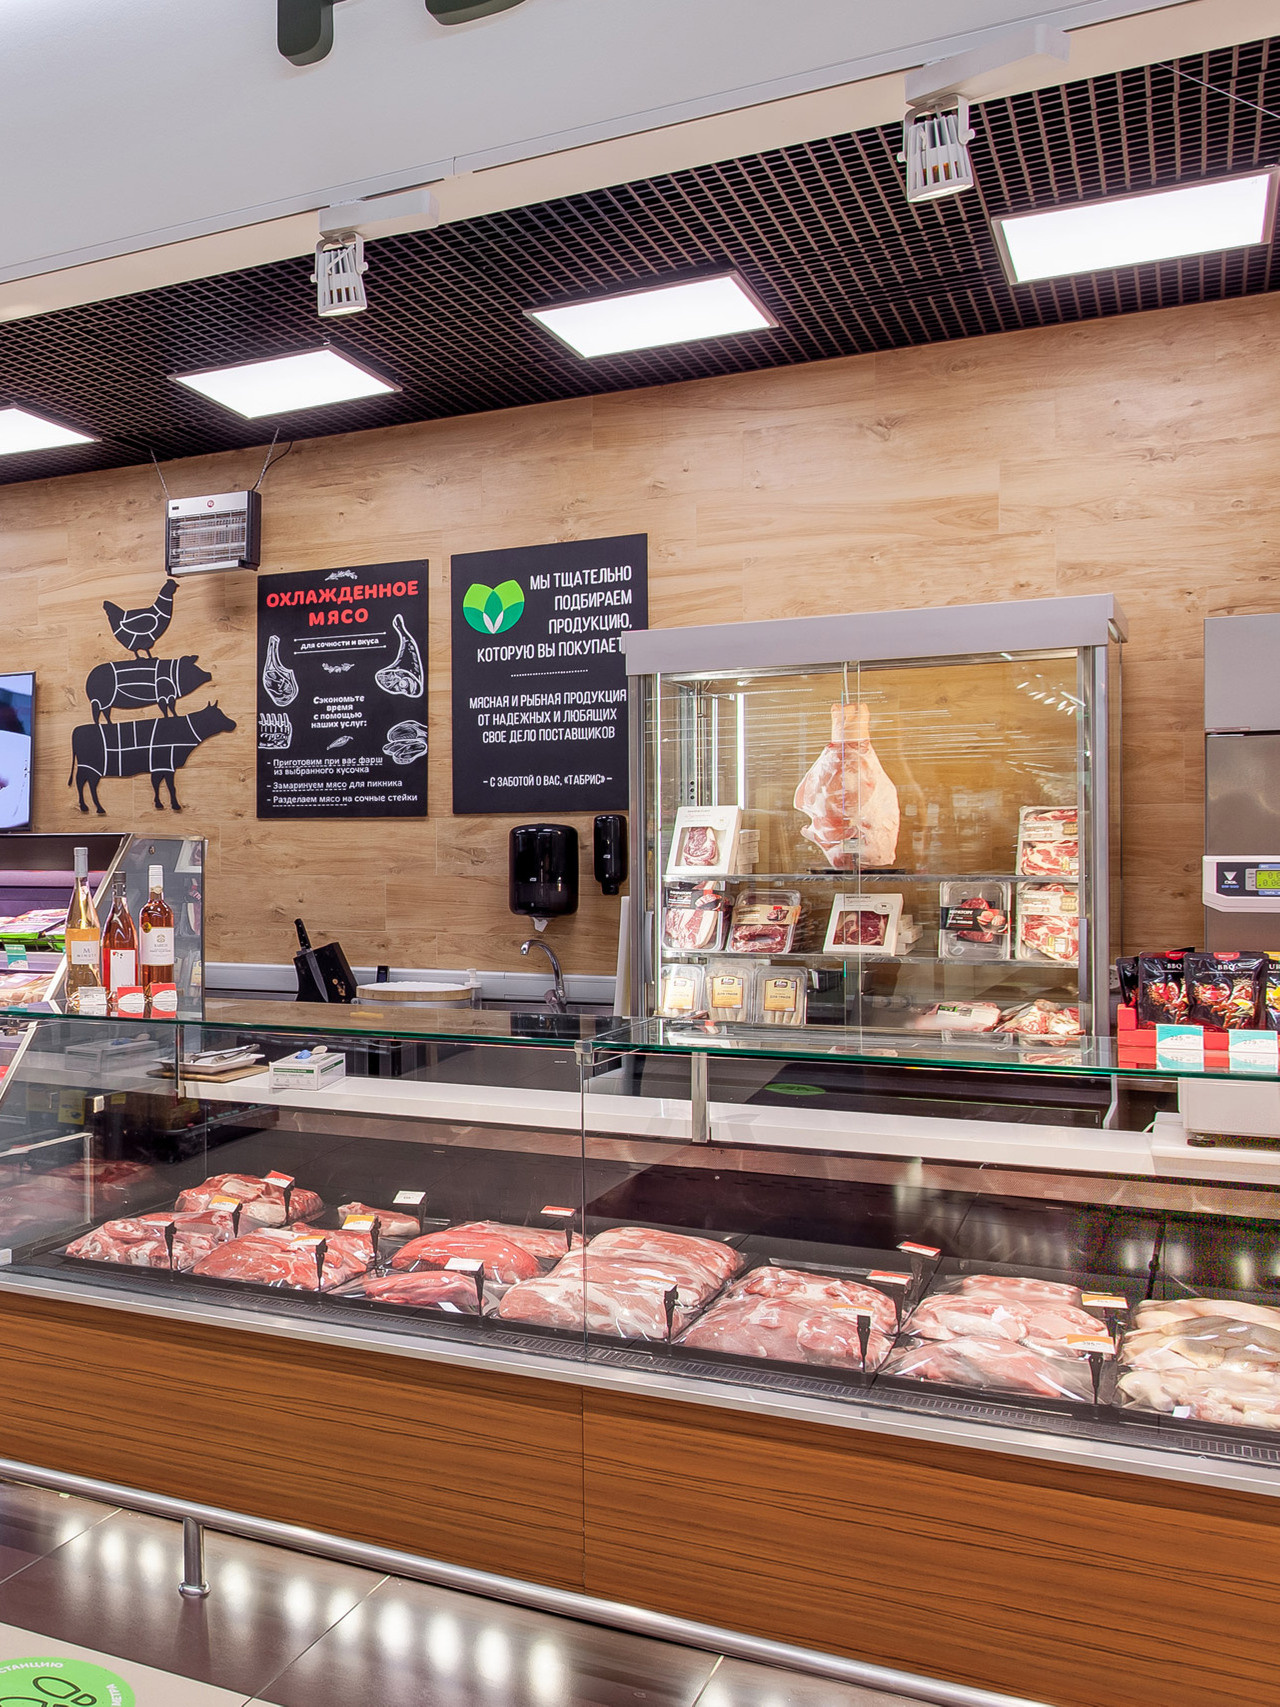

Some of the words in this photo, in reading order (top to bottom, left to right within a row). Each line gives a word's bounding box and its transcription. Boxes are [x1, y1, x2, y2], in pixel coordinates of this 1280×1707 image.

[530, 574, 550, 590] МЫ
[553, 565, 632, 588] ТЩАТЕЛЬНО
[266, 580, 419, 608] ОХЛАЖДЕННОЕ
[554, 588, 632, 612] ПОДБИРАЕМ
[308, 608, 369, 627] МЯСО
[548, 612, 632, 635] ПРОДУКЦИЮ,
[316, 640, 350, 648] сочности
[358, 638, 380, 646] вкуса
[477, 644, 534, 663] КОТОРУЮ
[538, 642, 556, 658] ВЫ
[558, 636, 622, 657] ПОКУПАЕТ
[313, 695, 365, 704] Сэкономьте
[470, 695, 510, 710] МЯСНАЯ
[512, 694, 519, 707] И
[520, 692, 561, 707] РЫБНАЯ
[563, 689, 627, 705] ПРОДУКЦИЯ
[326, 704, 354, 712] время
[320, 712, 362, 720] помощью
[478, 714, 490, 726] ОТ
[492, 711, 551, 726] НАДЕЖНЫХ
[553, 710, 560, 723] И
[563, 708, 617, 723] ЛЮБЯЩИХ
[311, 720, 339, 729] наших
[340, 720, 368, 730] услуг:
[482, 730, 506, 744] СВОЕ
[509, 729, 536, 744] ДЕЛО
[538, 726, 616, 742] ПОСТАВЩИКОВ
[273, 758, 322, 769] Приготовим
[324, 758, 340, 767] при
[358, 756, 383, 767] фарш
[284, 767, 334, 776] выбранного
[336, 766, 370, 776] кусочка
[272, 782, 324, 791] Замаринуем
[349, 781, 365, 790] для
[367, 780, 403, 788] пикника
[490, 776, 496, 787] С
[497, 774, 535, 787] ЗАБОТОЙ
[536, 776, 542, 786] О
[564, 774, 606, 786] «ТАБРИС»
[272, 795, 317, 804] Разделаем
[388, 794, 418, 802] стейки
